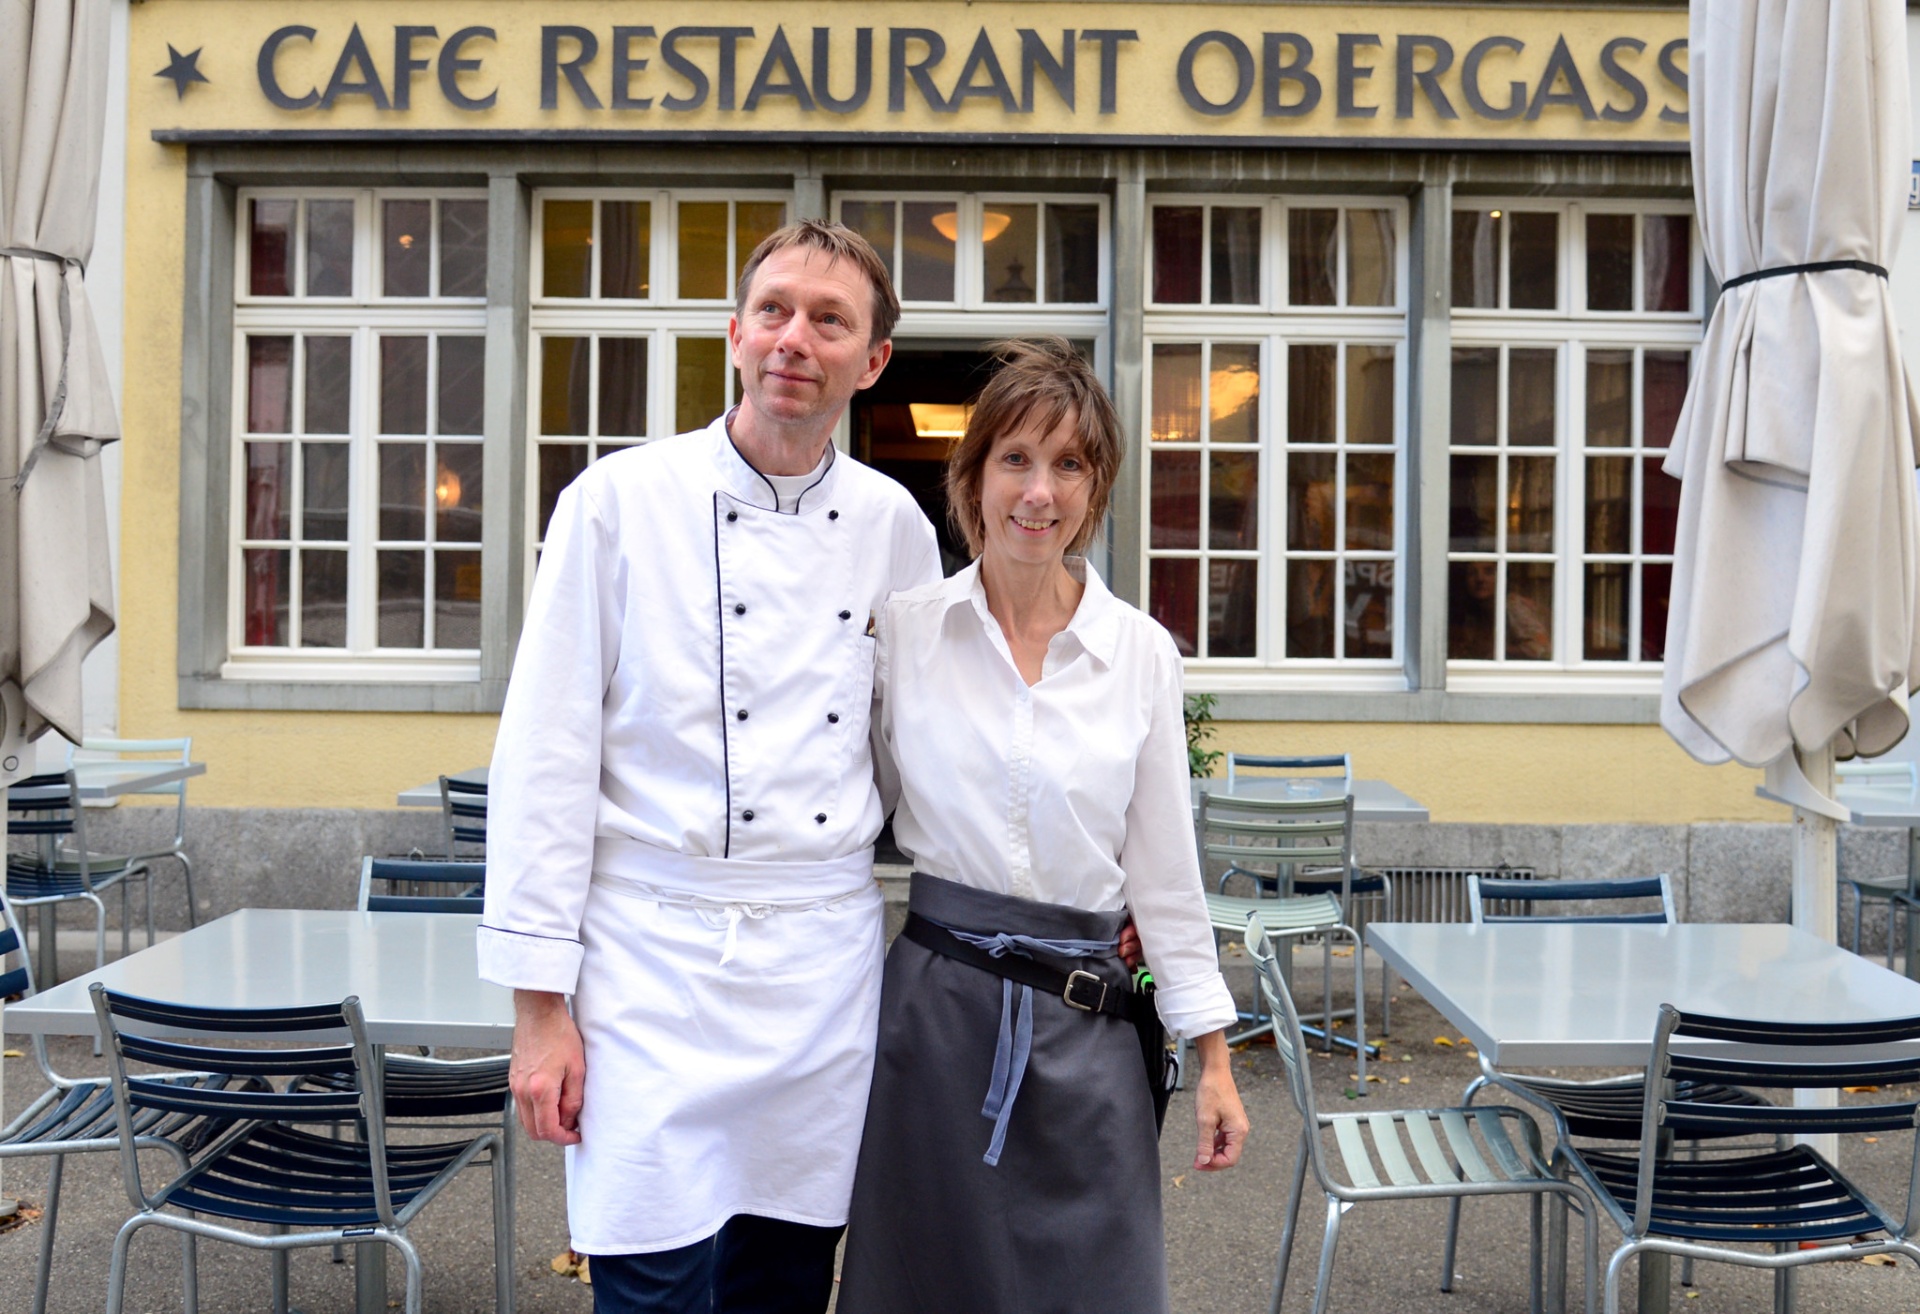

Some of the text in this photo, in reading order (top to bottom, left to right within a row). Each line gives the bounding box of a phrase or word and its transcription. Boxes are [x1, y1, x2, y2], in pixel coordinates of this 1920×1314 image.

[257, 23, 1690, 123] CAFE RESTAURANT OBERGASS
